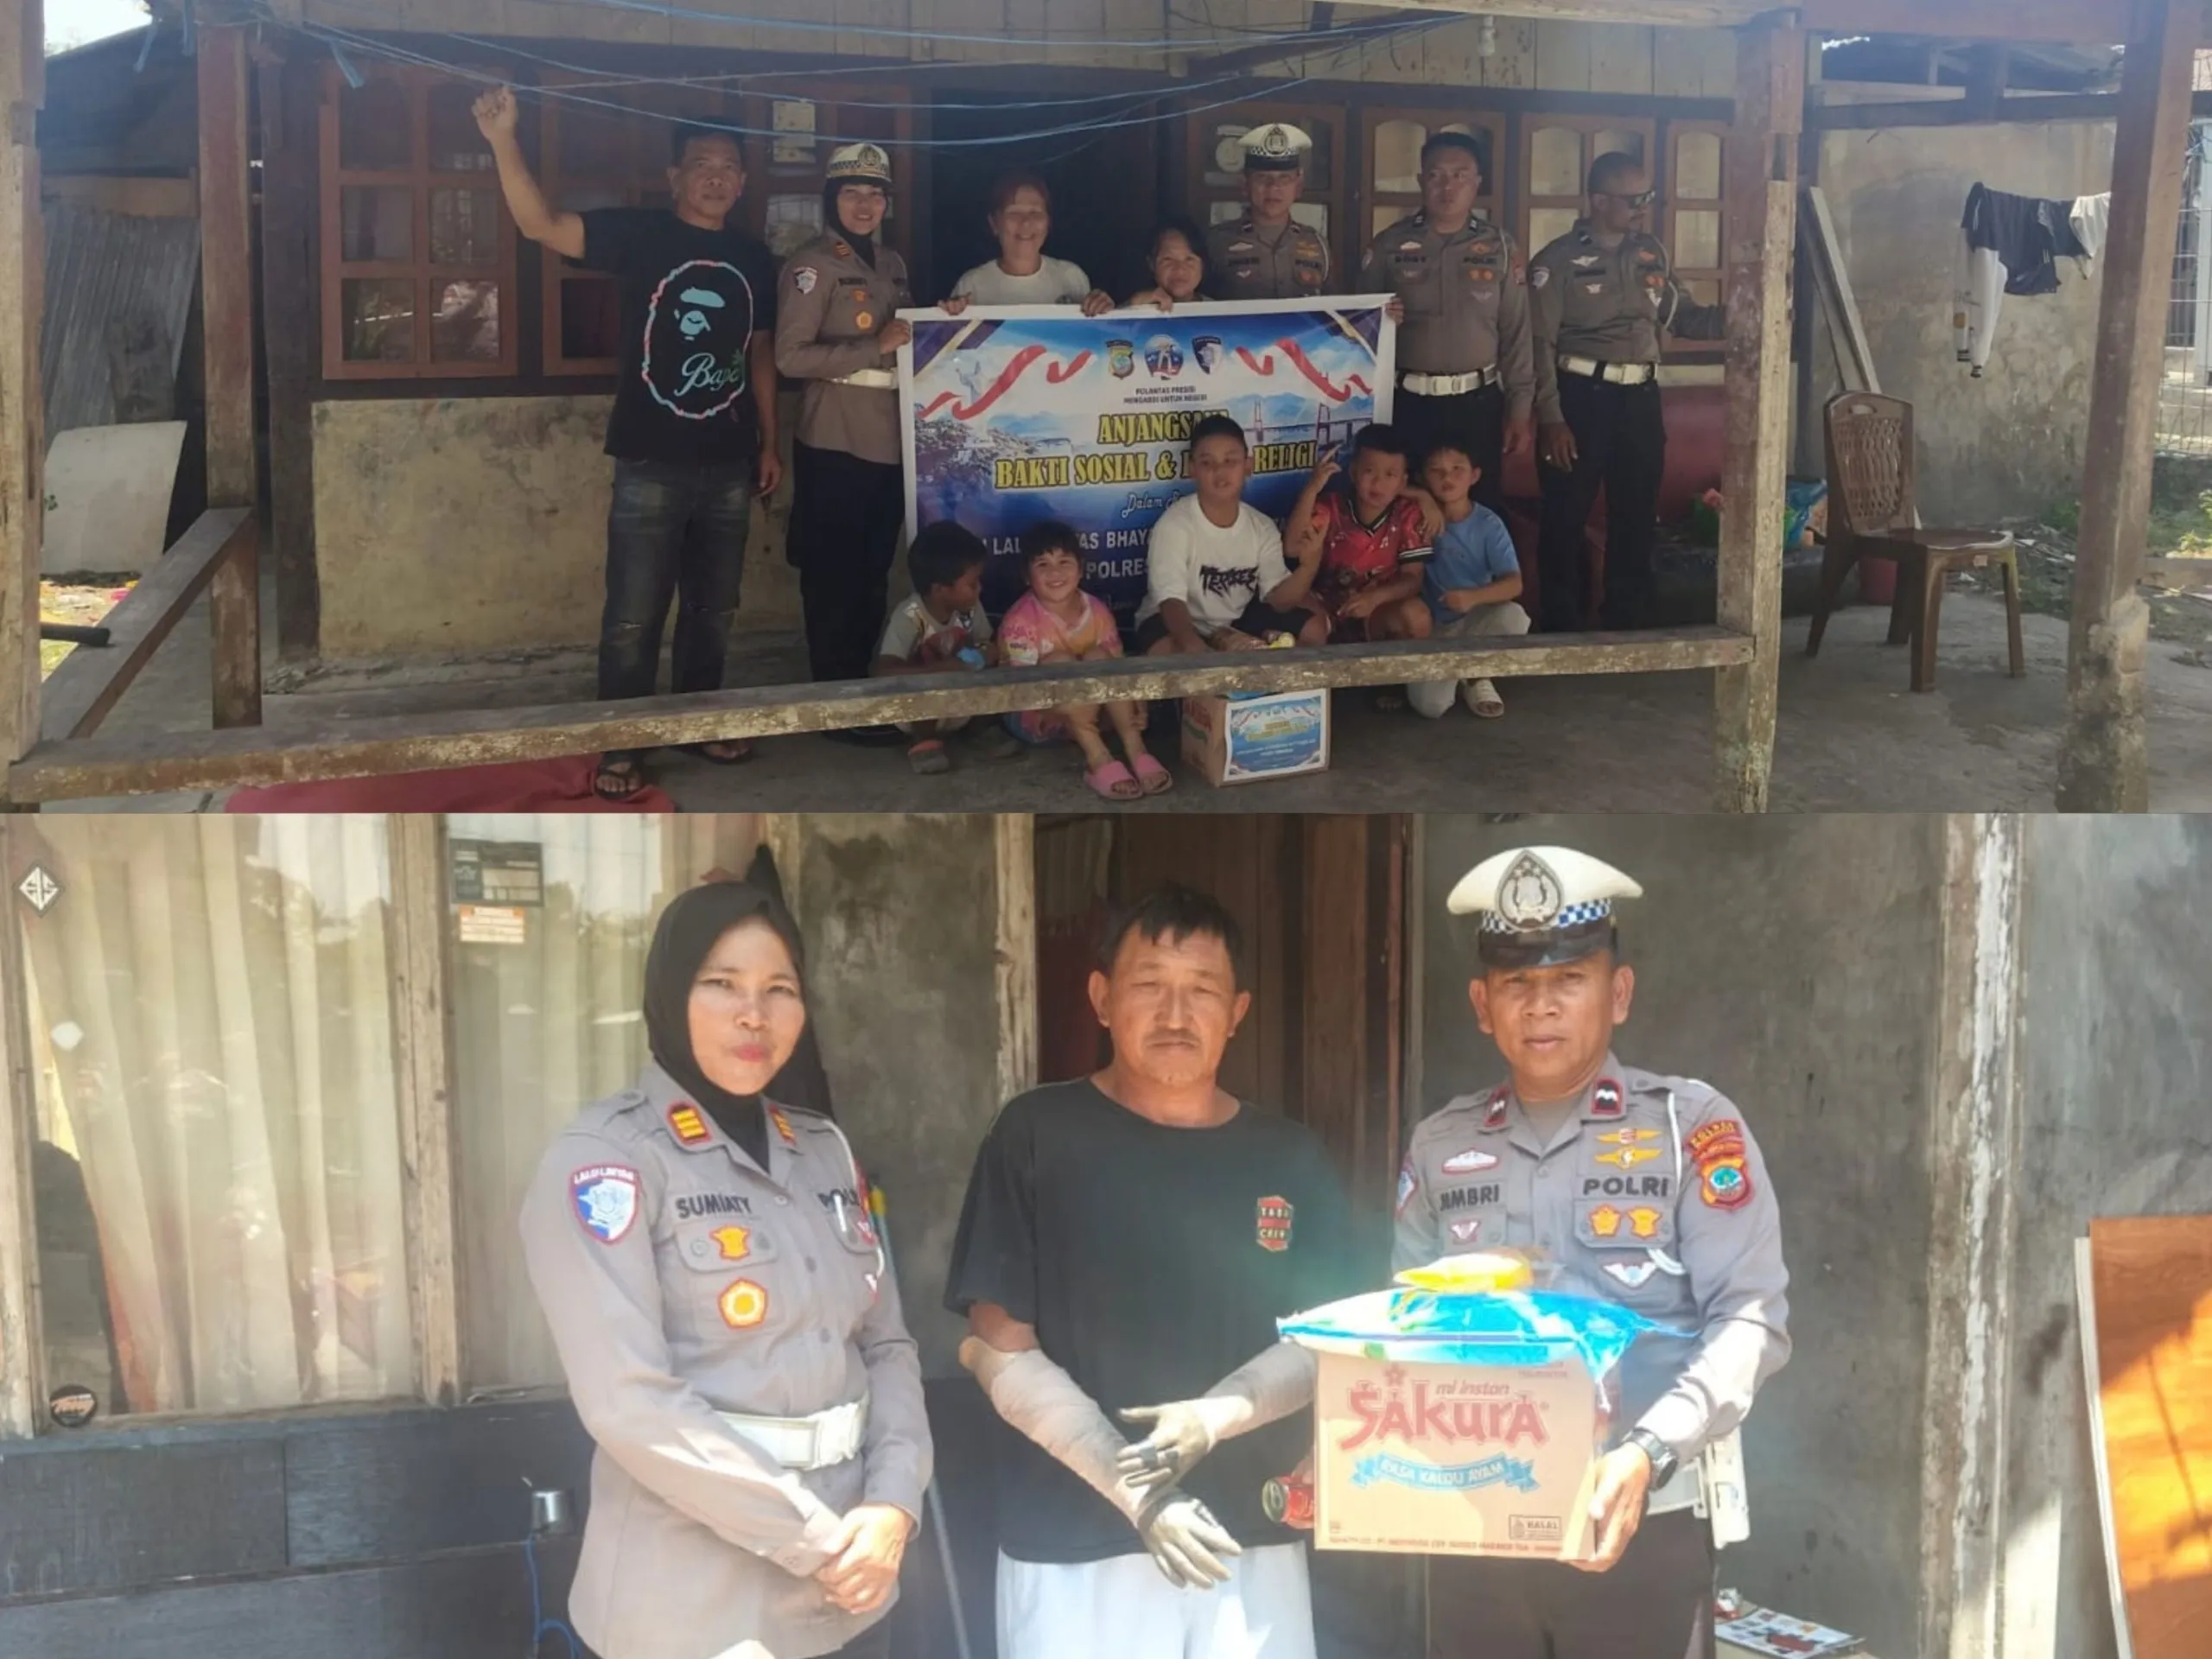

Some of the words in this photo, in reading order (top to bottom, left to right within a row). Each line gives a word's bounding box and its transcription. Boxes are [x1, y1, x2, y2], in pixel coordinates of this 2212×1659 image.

[995, 456, 1069, 490] BAKTI
[1074, 451, 1151, 485] SOSIAL
[1155, 449, 1177, 480] &
[1253, 440, 1318, 474] RELIGI
[1122, 493, 1163, 518] Dalam
[1086, 558, 1150, 580] POLRE
[1582, 1175, 1669, 1198] POLRI
[675, 1193, 753, 1219] SUMIATY
[1435, 1379, 1457, 1395] mi
